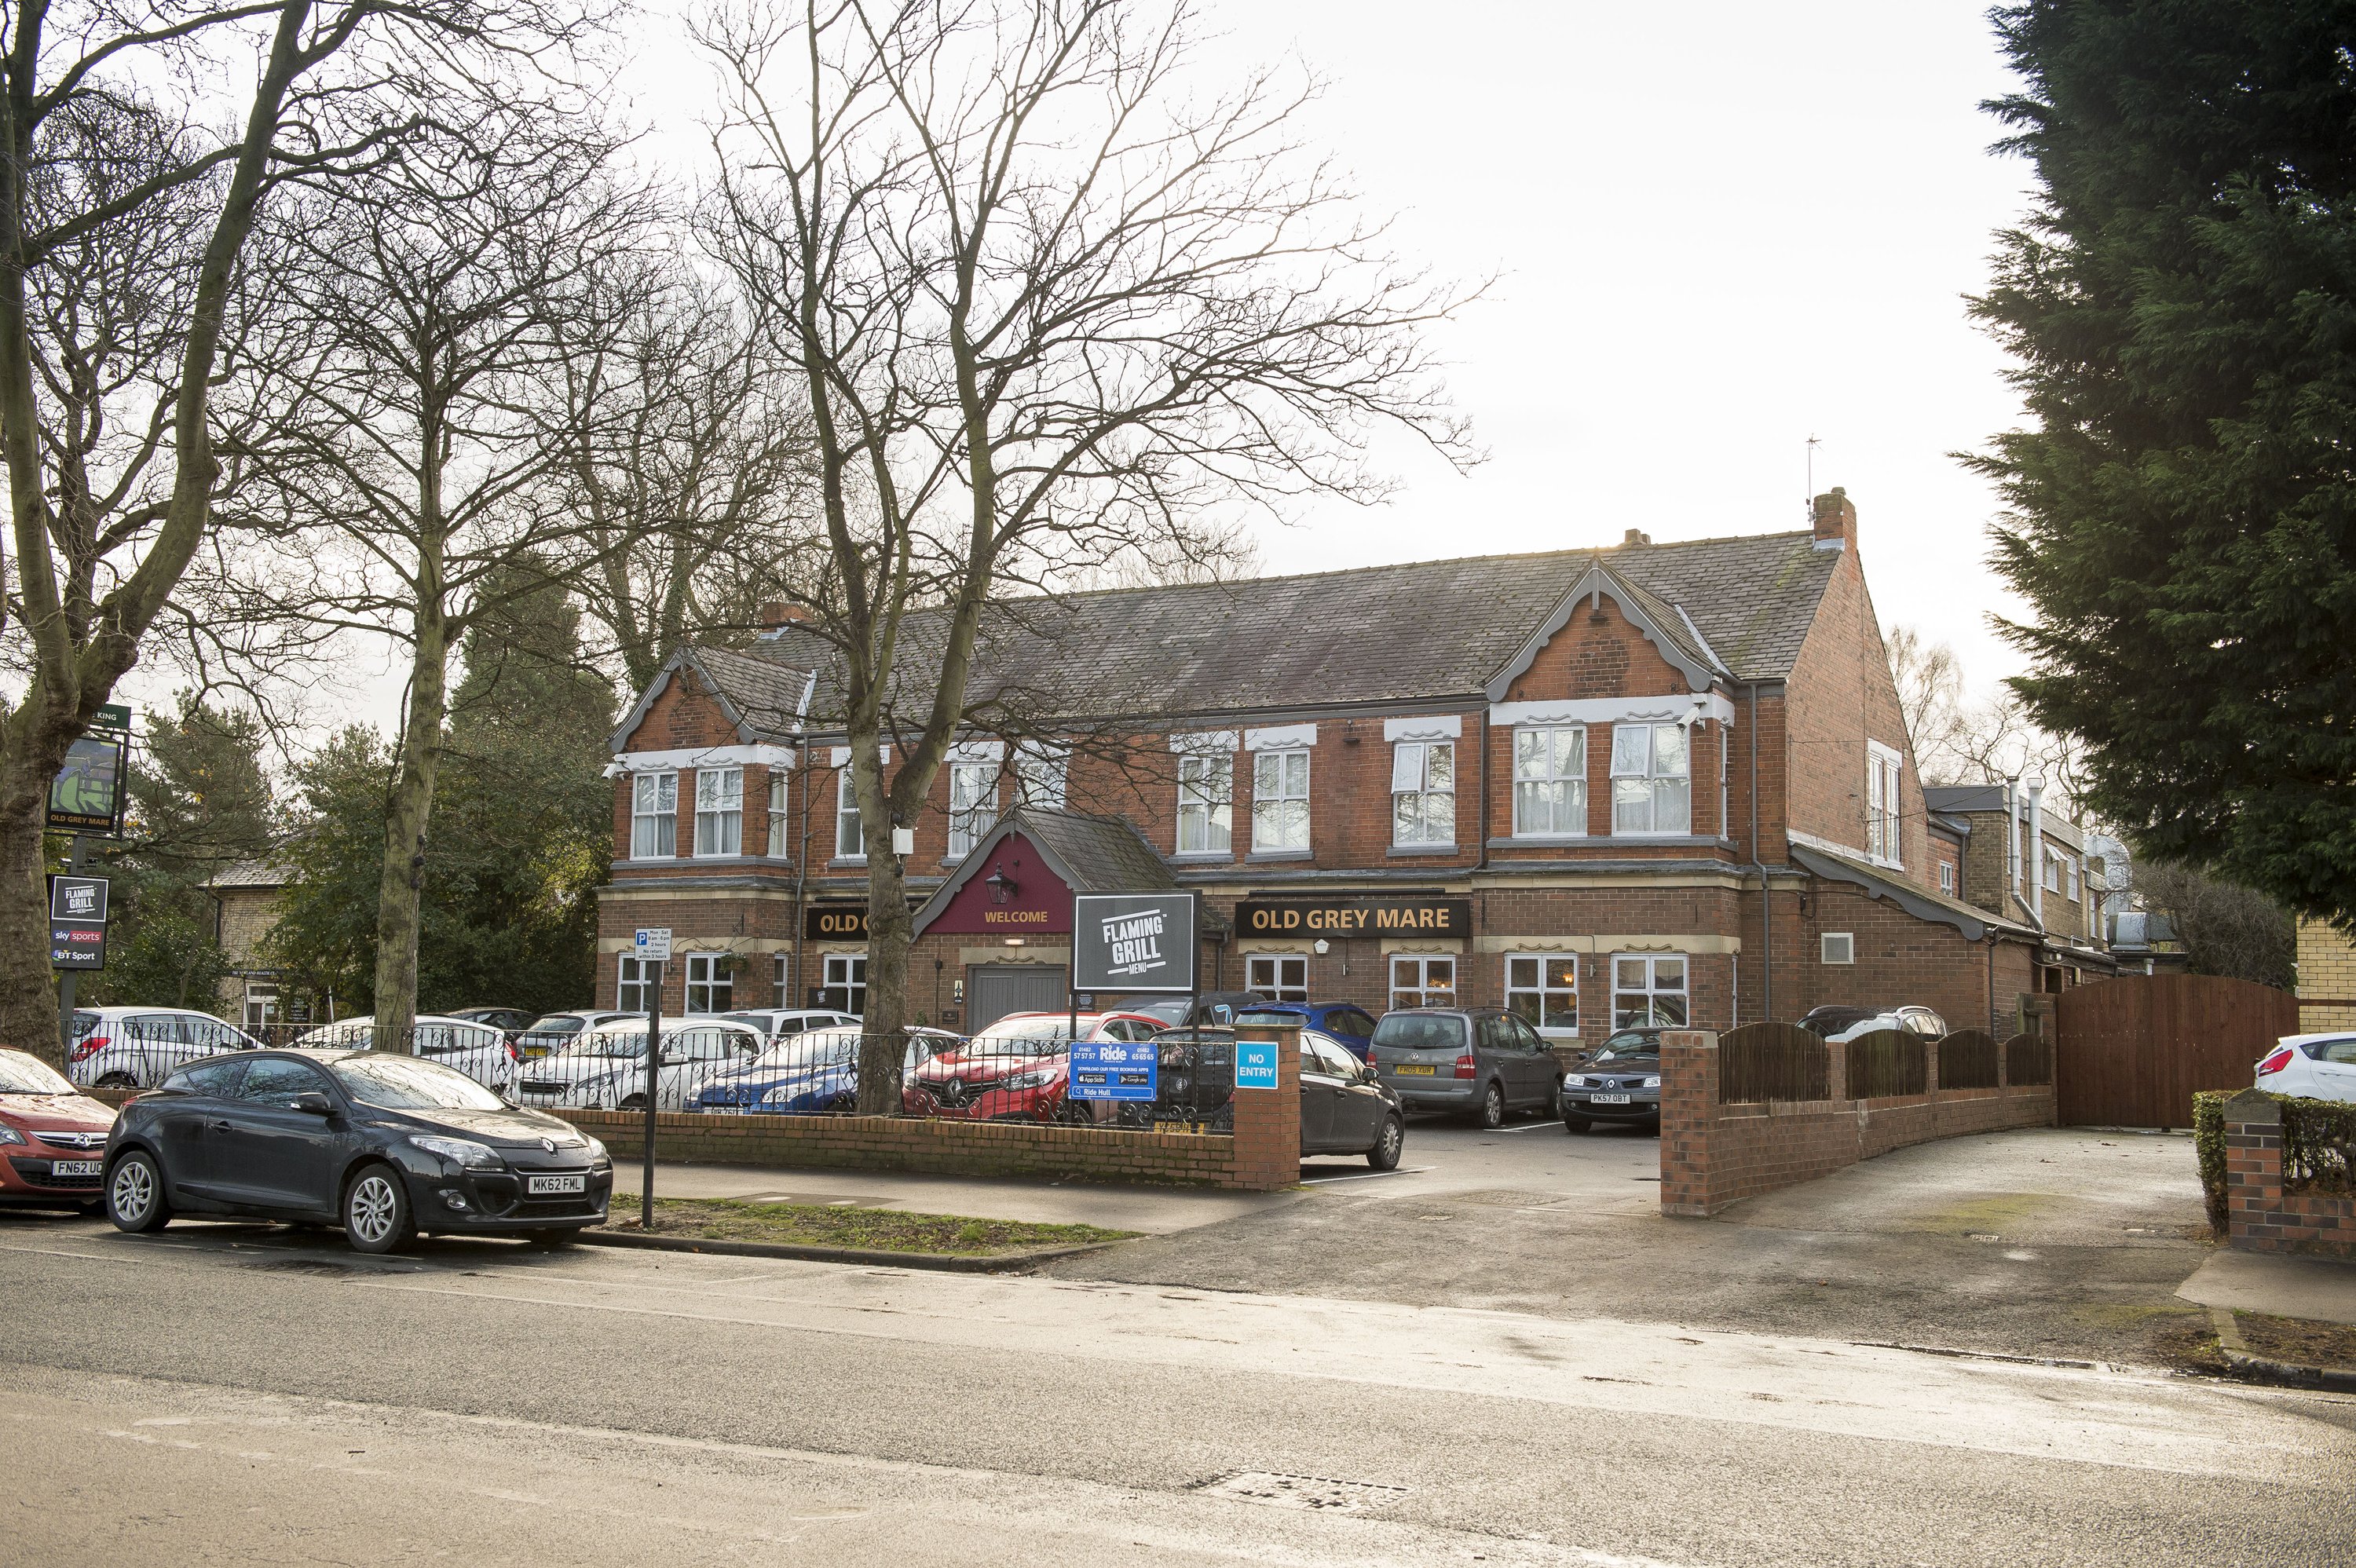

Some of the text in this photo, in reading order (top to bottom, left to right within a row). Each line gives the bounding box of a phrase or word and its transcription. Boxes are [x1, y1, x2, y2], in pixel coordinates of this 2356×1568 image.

[97, 712, 116, 721] KING
[66, 889, 94, 899] FLAMING
[69, 897, 93, 908] GRILL
[985, 912, 1048, 923] WELCOME
[1253, 908, 1449, 929] OLD GREY MARE
[821, 915, 858, 932] OLD
[1103, 916, 1162, 943] FLAMING
[55, 931, 69, 941] sky
[639, 934, 646, 944] P
[72, 952, 95, 960] Sport
[1112, 937, 1161, 964] GRILL
[1129, 962, 1147, 974] MENU
[1100, 1045, 1127, 1060] Ride
[1249, 1054, 1264, 1063] NO
[1239, 1067, 1273, 1077] ENTRY
[58, 1162, 87, 1173] FN62
[534, 1178, 580, 1190] MK62 FML
